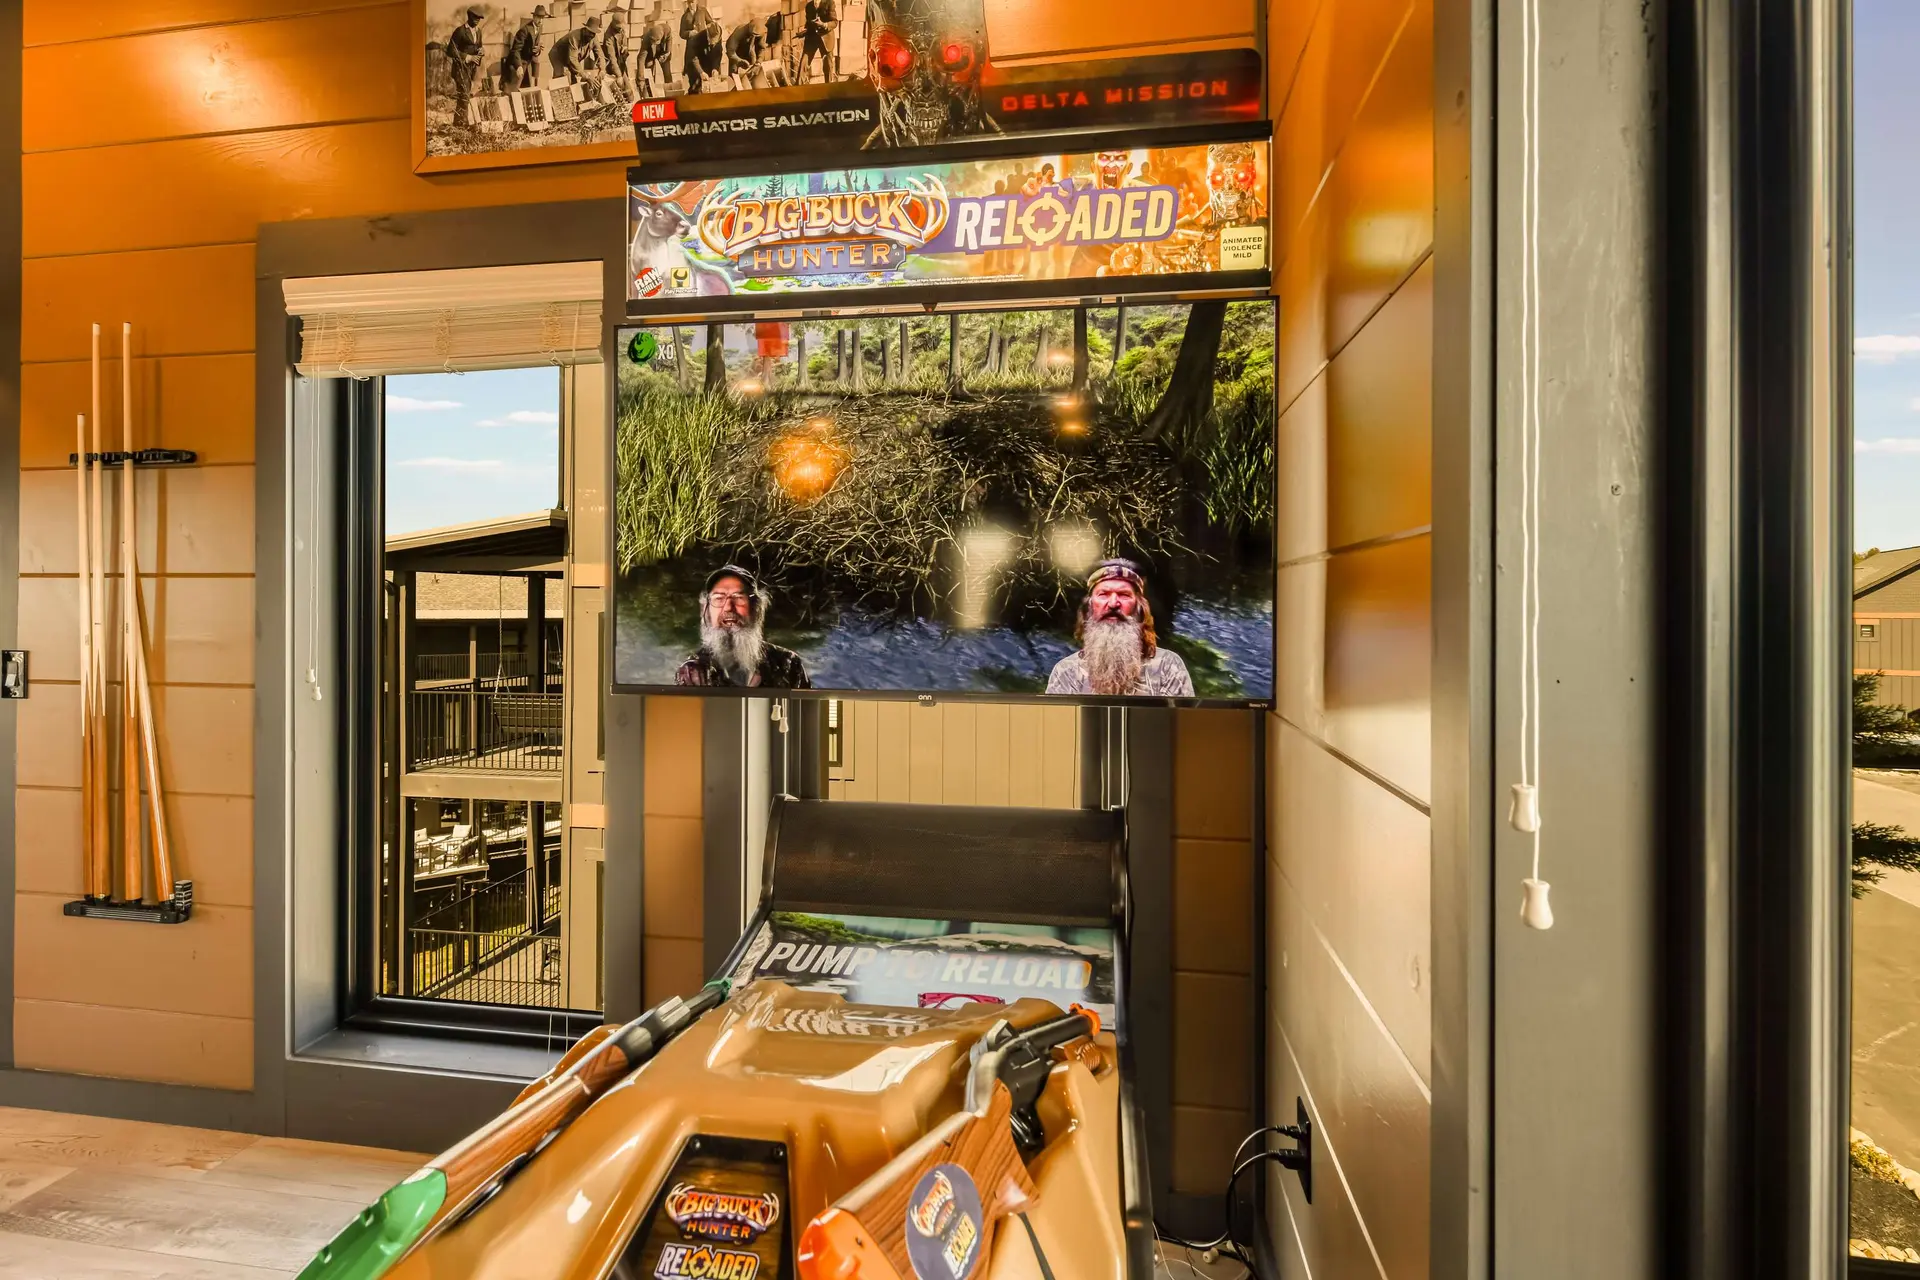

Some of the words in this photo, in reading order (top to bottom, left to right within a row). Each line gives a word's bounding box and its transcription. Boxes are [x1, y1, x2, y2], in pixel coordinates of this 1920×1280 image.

[1002, 91, 1089, 112] DELTA
[1106, 80, 1228, 105] MISSION
[641, 104, 665, 120] NEW
[641, 118, 758, 140] TERMINATOR
[764, 108, 870, 129] SALVATION
[725, 197, 801, 250] BIG
[806, 190, 924, 243] BUCK
[954, 189, 1175, 250] RELOADED
[1222, 235, 1263, 246] ANIMATED
[1223, 243, 1262, 252] VIOLENCE
[752, 243, 892, 271] HUNTER
[1233, 251, 1252, 259] MILD
[634, 267, 661, 290] RAW
[638, 276, 664, 297] THRILLS
[760, 942, 879, 977] PUMP
[941, 953, 1093, 990] RELOAD
[680, 1191, 716, 1217] BIG
[718, 1197, 766, 1227] BUCK
[687, 1220, 751, 1239] HUNTER
[658, 1246, 756, 1280] RELOADED
